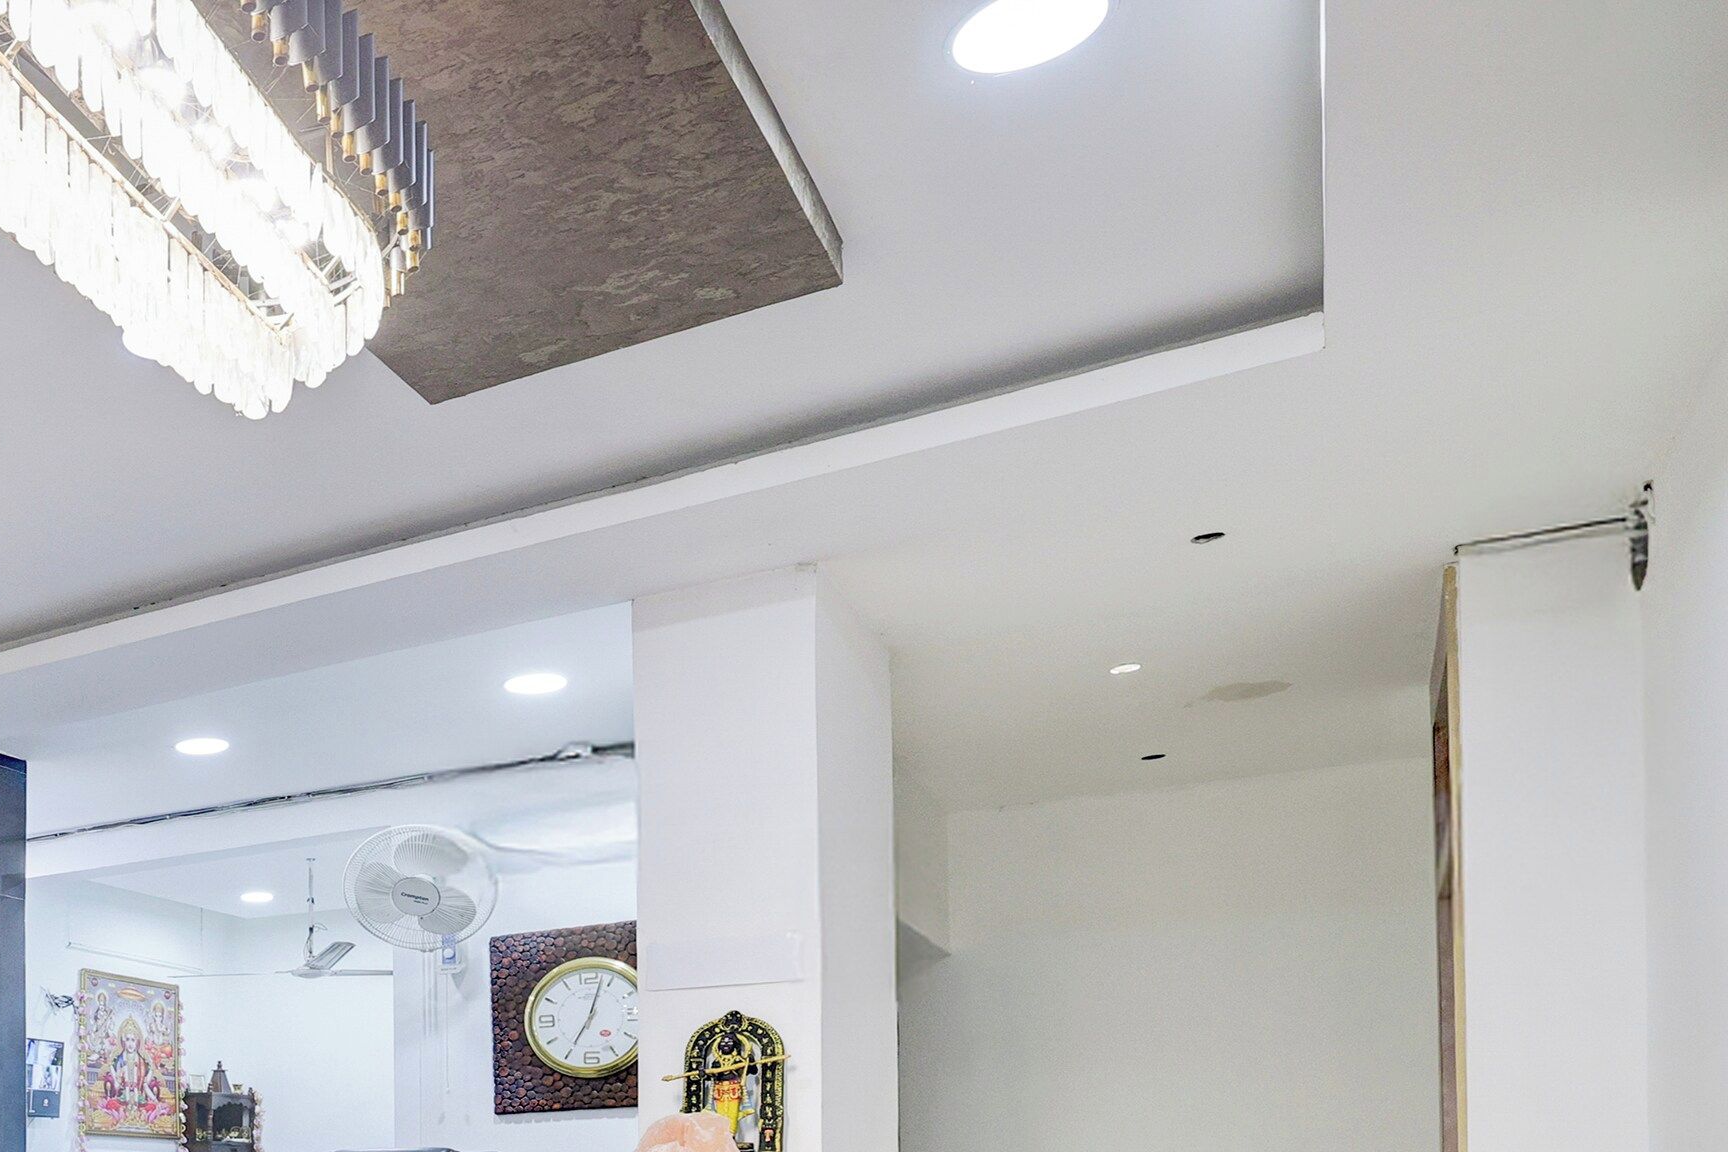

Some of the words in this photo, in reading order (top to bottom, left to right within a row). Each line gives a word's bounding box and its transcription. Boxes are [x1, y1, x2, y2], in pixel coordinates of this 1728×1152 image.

[578, 972, 599, 985] 12
[538, 1014, 556, 1029] 9
[583, 1051, 601, 1065] 6
